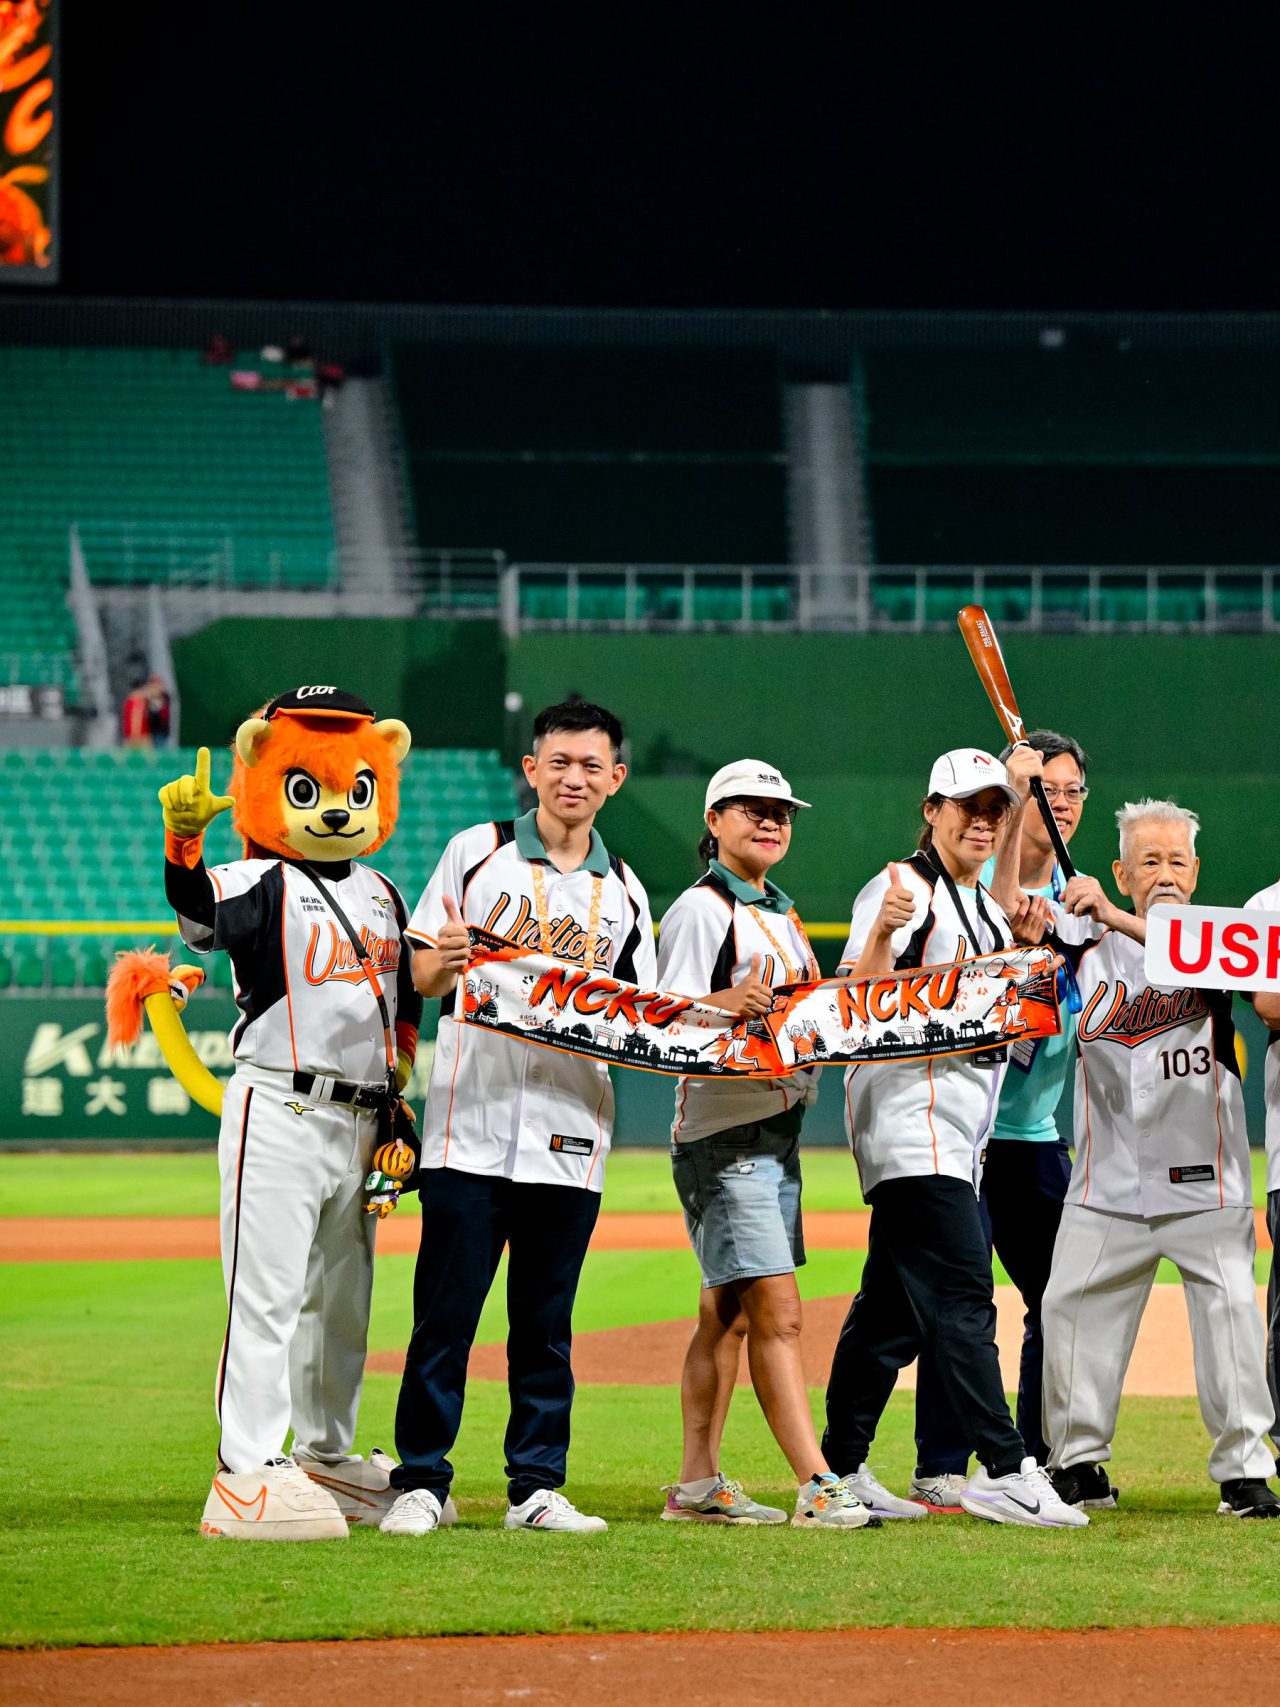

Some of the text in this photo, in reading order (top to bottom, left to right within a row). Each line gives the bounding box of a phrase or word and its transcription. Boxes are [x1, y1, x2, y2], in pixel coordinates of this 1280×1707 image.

[528, 966, 695, 1028] NCKU
[837, 966, 962, 1031] NCKU
[1159, 1045, 1211, 1080] 103
